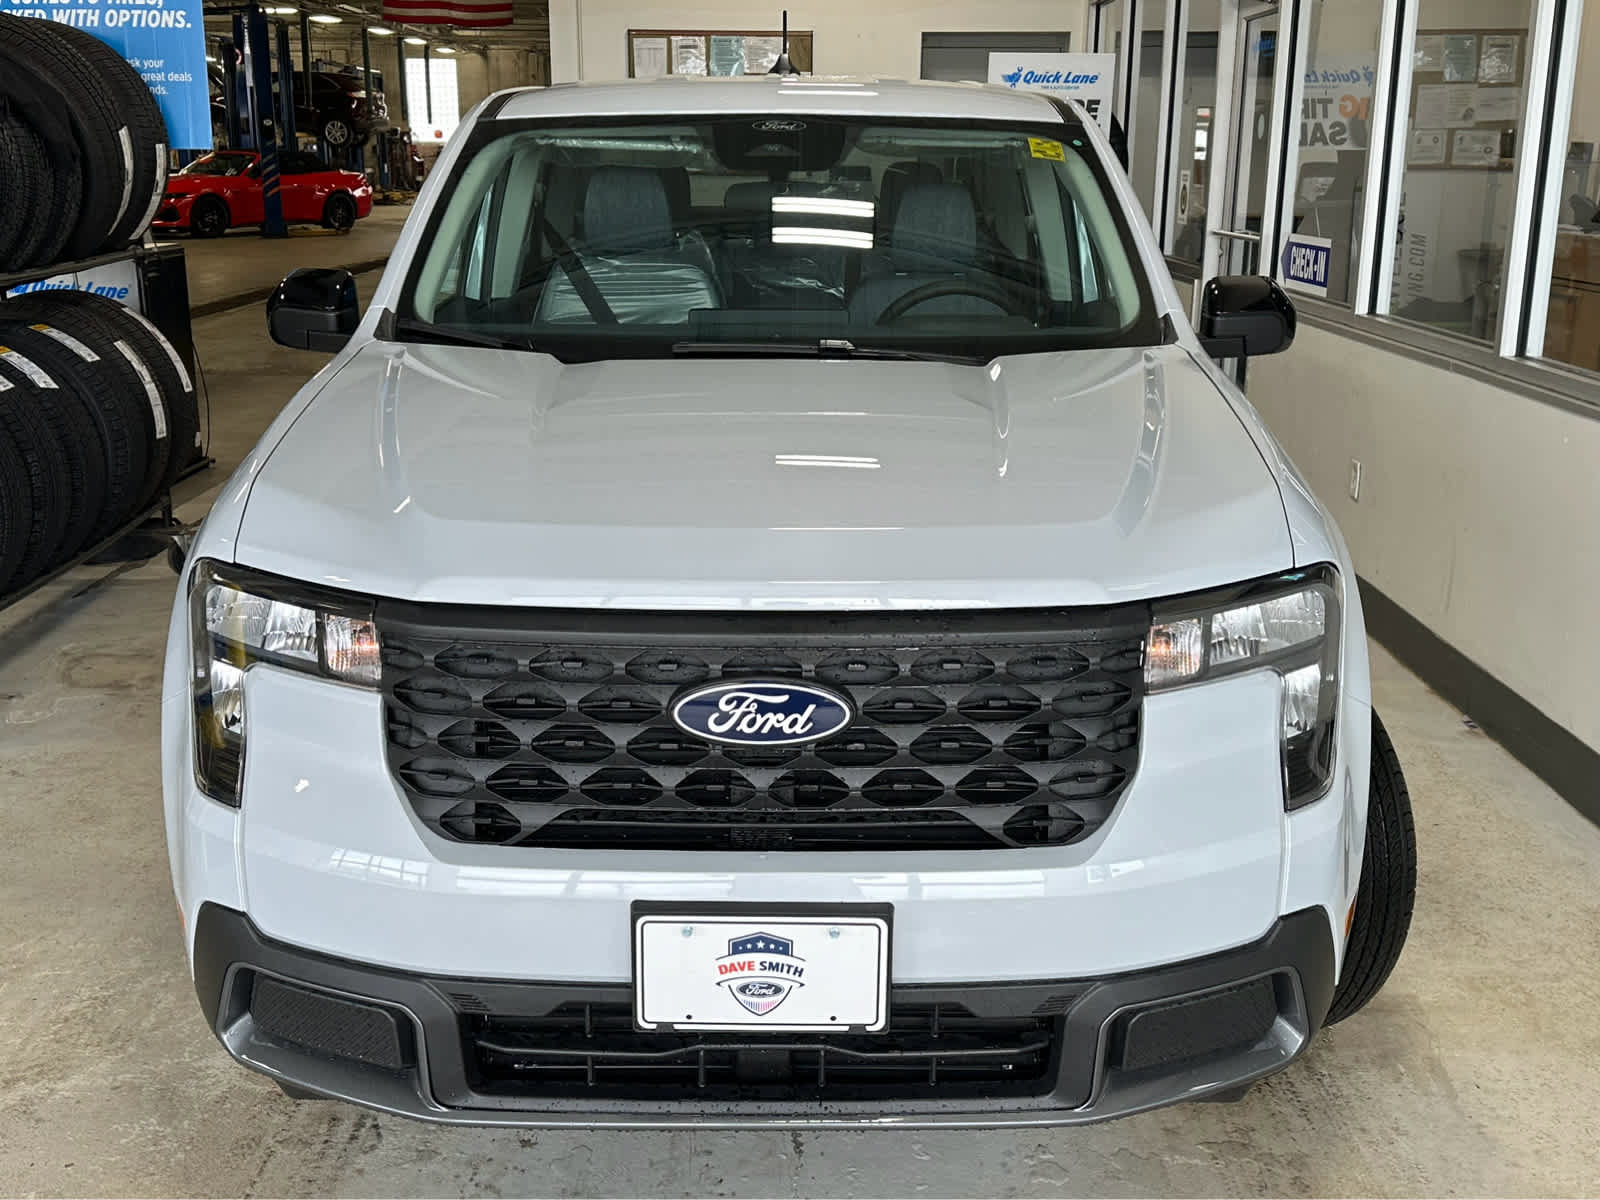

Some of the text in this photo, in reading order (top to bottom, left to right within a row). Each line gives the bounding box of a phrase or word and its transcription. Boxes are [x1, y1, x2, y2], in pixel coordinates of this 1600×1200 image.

[52, 9, 100, 27] WITH
[104, 9, 192, 28] OPTIONS.
[143, 58, 164, 70] your
[141, 72, 192, 84] great deals
[1023, 70, 1100, 85] Quick Lane
[1290, 246, 1327, 283] CHECK-IN
[86, 281, 129, 299] Lane
[707, 691, 816, 734] Ford
[718, 960, 804, 978] DAVE SMITH
[745, 983, 776, 995] Ford
